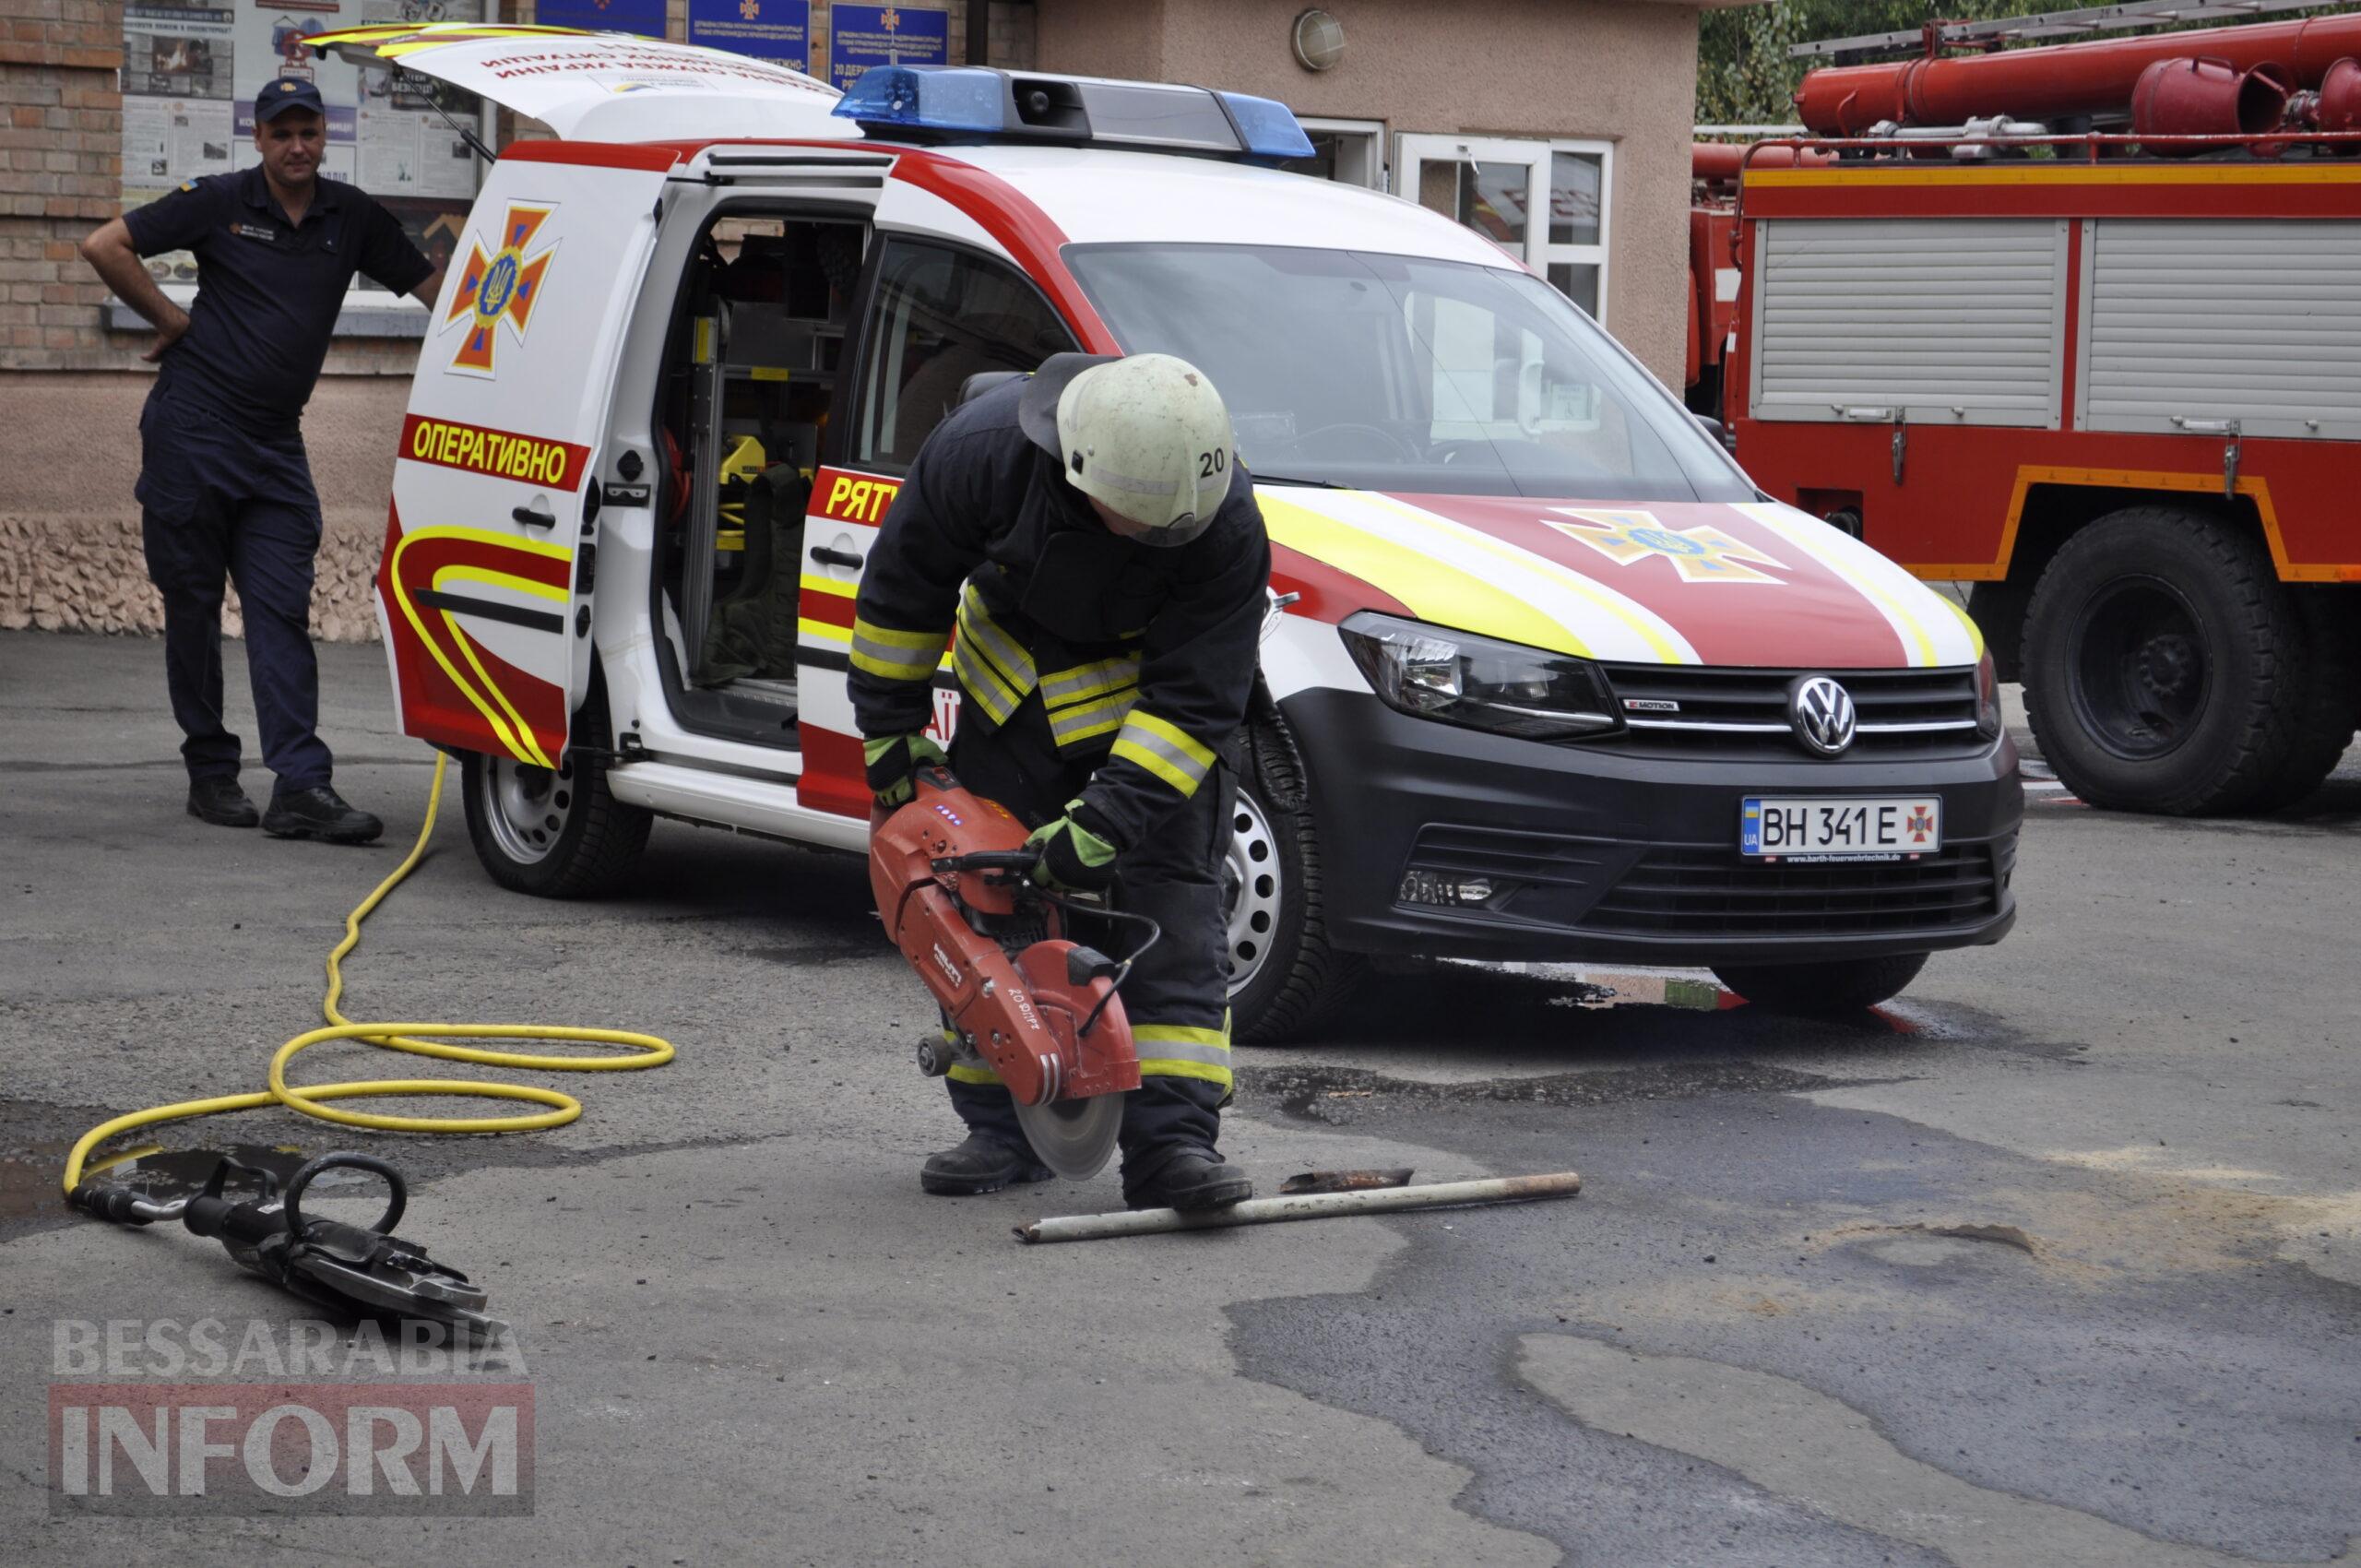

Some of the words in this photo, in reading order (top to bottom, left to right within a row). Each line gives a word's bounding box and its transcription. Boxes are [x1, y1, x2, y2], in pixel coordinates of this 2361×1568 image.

[481, 53, 617, 68] СИТУАЦІЙ
[494, 61, 612, 79] УКРАЇНИ
[413, 421, 566, 484] ОПЕРАТИВНО
[1199, 447, 1225, 479] 20
[1817, 806, 1868, 846] 341
[1744, 833, 1759, 847] UA
[1786, 852, 1902, 864] www.barth-feuerwehrtechnik.de
[1007, 988, 1026, 1004] 20
